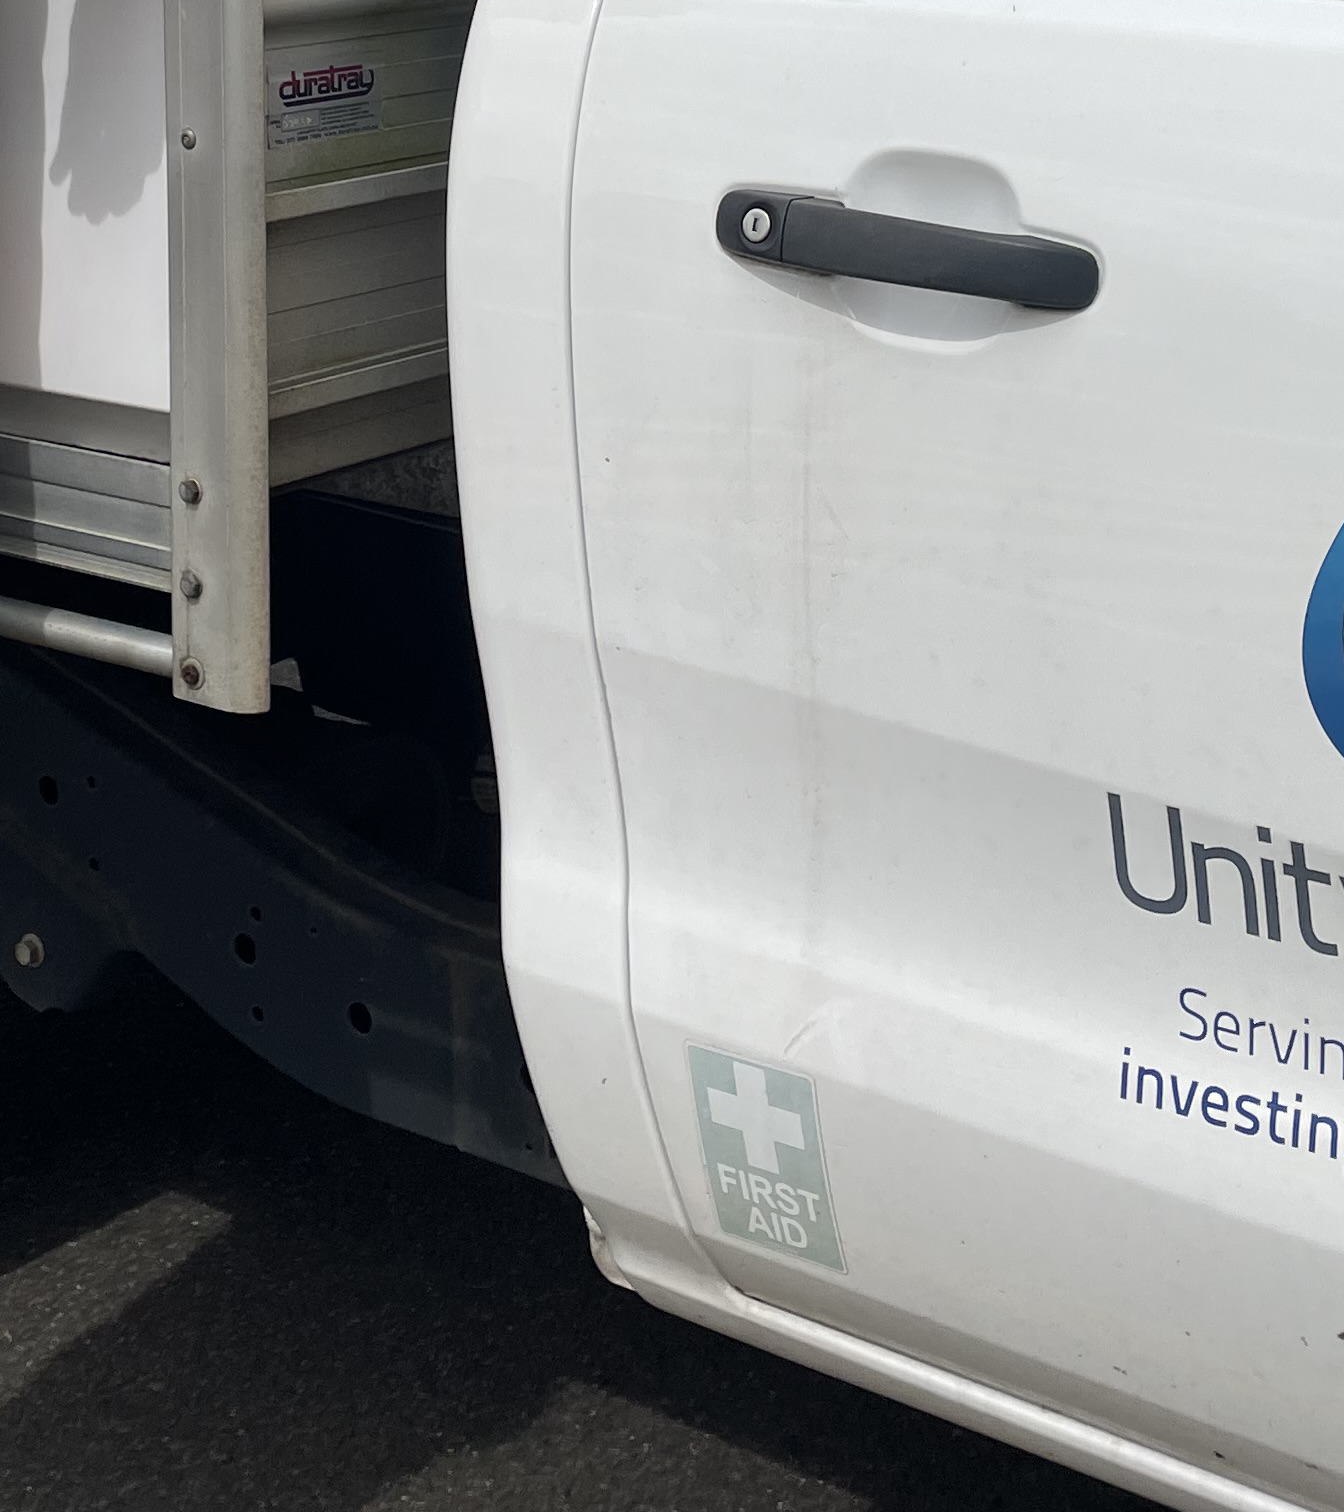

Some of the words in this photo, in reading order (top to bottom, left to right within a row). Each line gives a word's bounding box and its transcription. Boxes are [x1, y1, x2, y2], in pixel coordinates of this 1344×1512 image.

[279, 65, 374, 105] duratray
[717, 1163, 820, 1223] FIRST
[748, 1207, 808, 1249] AID
